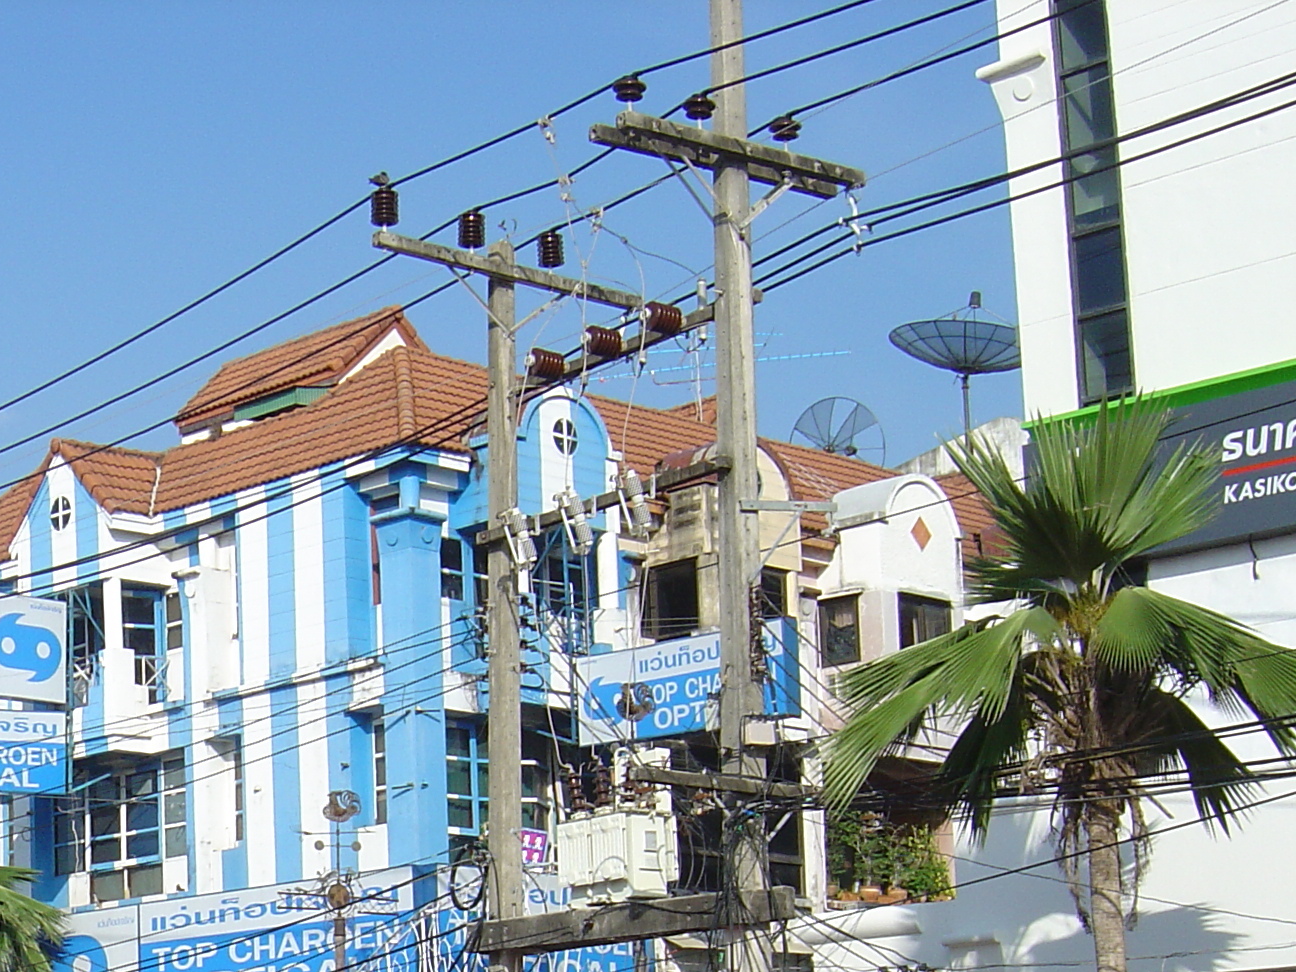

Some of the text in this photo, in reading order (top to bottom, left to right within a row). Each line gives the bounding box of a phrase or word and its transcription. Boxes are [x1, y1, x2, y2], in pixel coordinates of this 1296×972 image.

[649, 681, 678, 705] OP
[152, 941, 217, 972] TOP
[228, 920, 401, 963] CHAROEN
